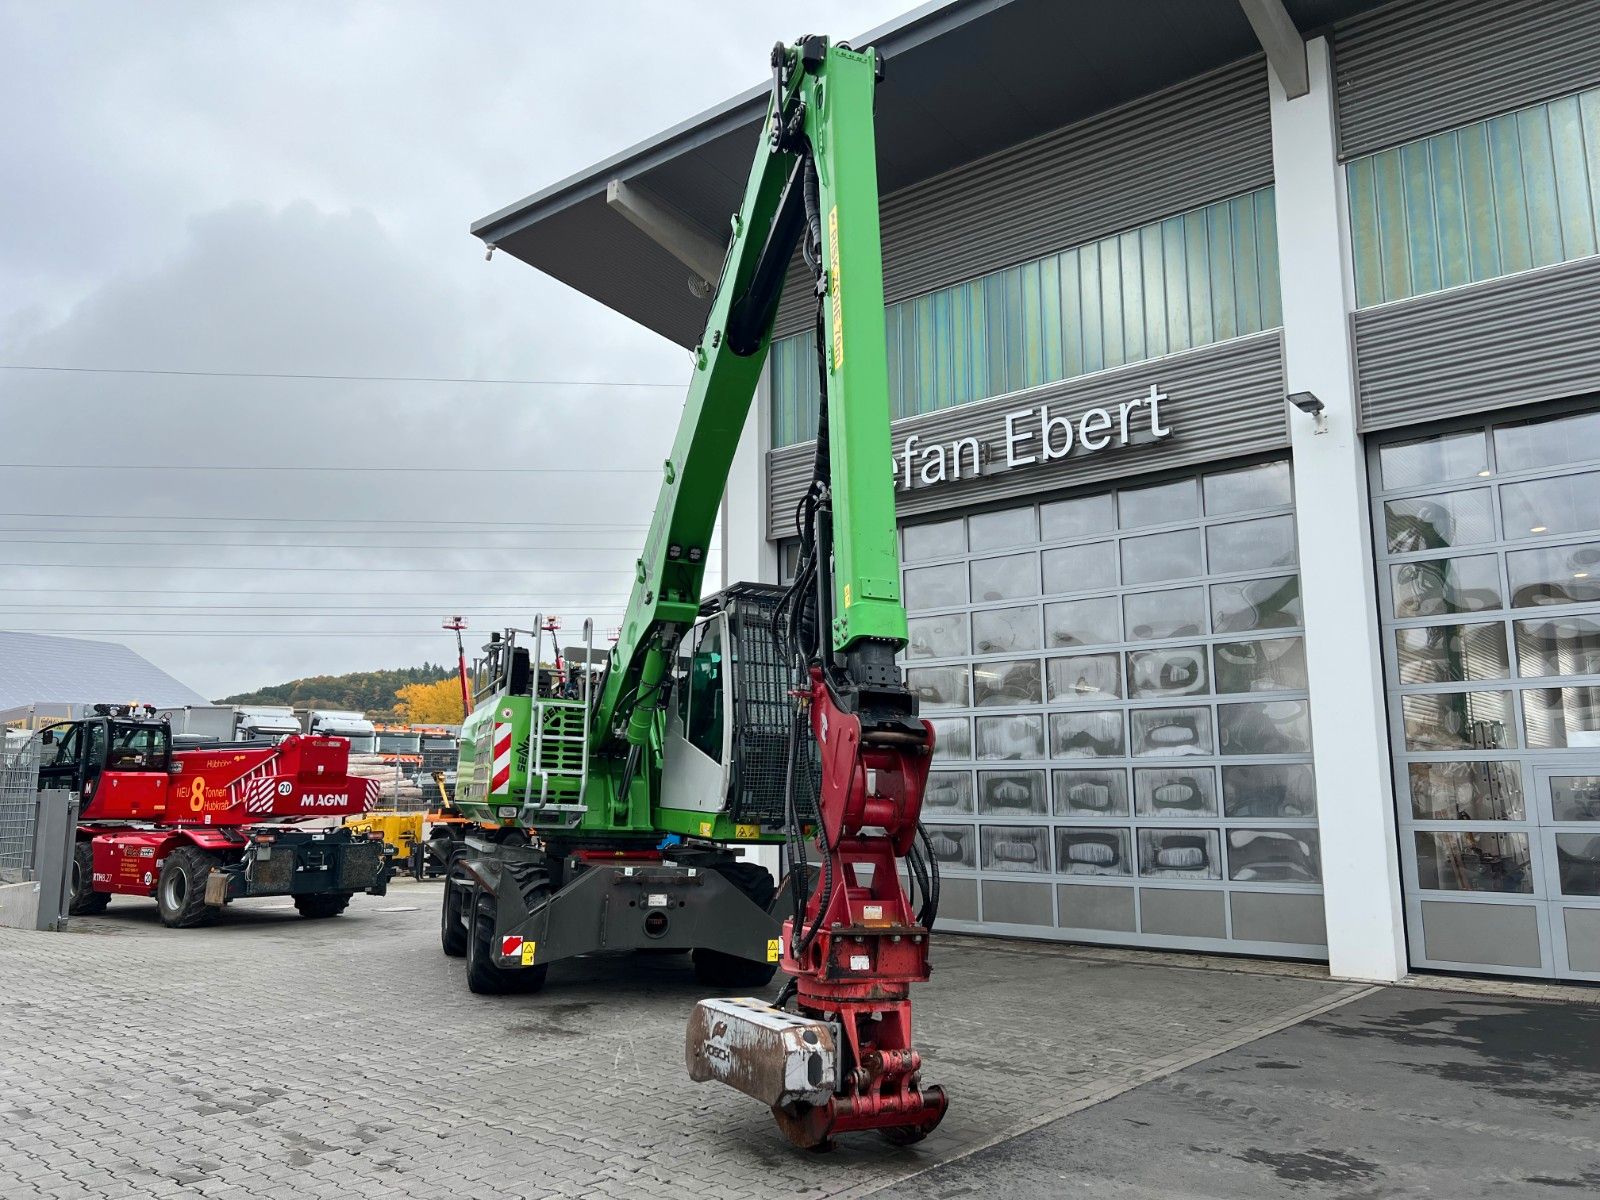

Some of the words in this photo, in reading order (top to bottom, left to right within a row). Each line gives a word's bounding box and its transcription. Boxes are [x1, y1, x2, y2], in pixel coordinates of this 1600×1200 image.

[832, 272, 842, 322] ZONE
[892, 435, 979, 488] fan
[1005, 384, 1170, 467] Ebert
[176, 786, 190, 797] NEU
[189, 776, 206, 811] 8
[204, 786, 227, 797] Tonnen
[280, 784, 290, 793] 20
[300, 794, 349, 806] MAGNI
[203, 801, 229, 811] Hubkraft
